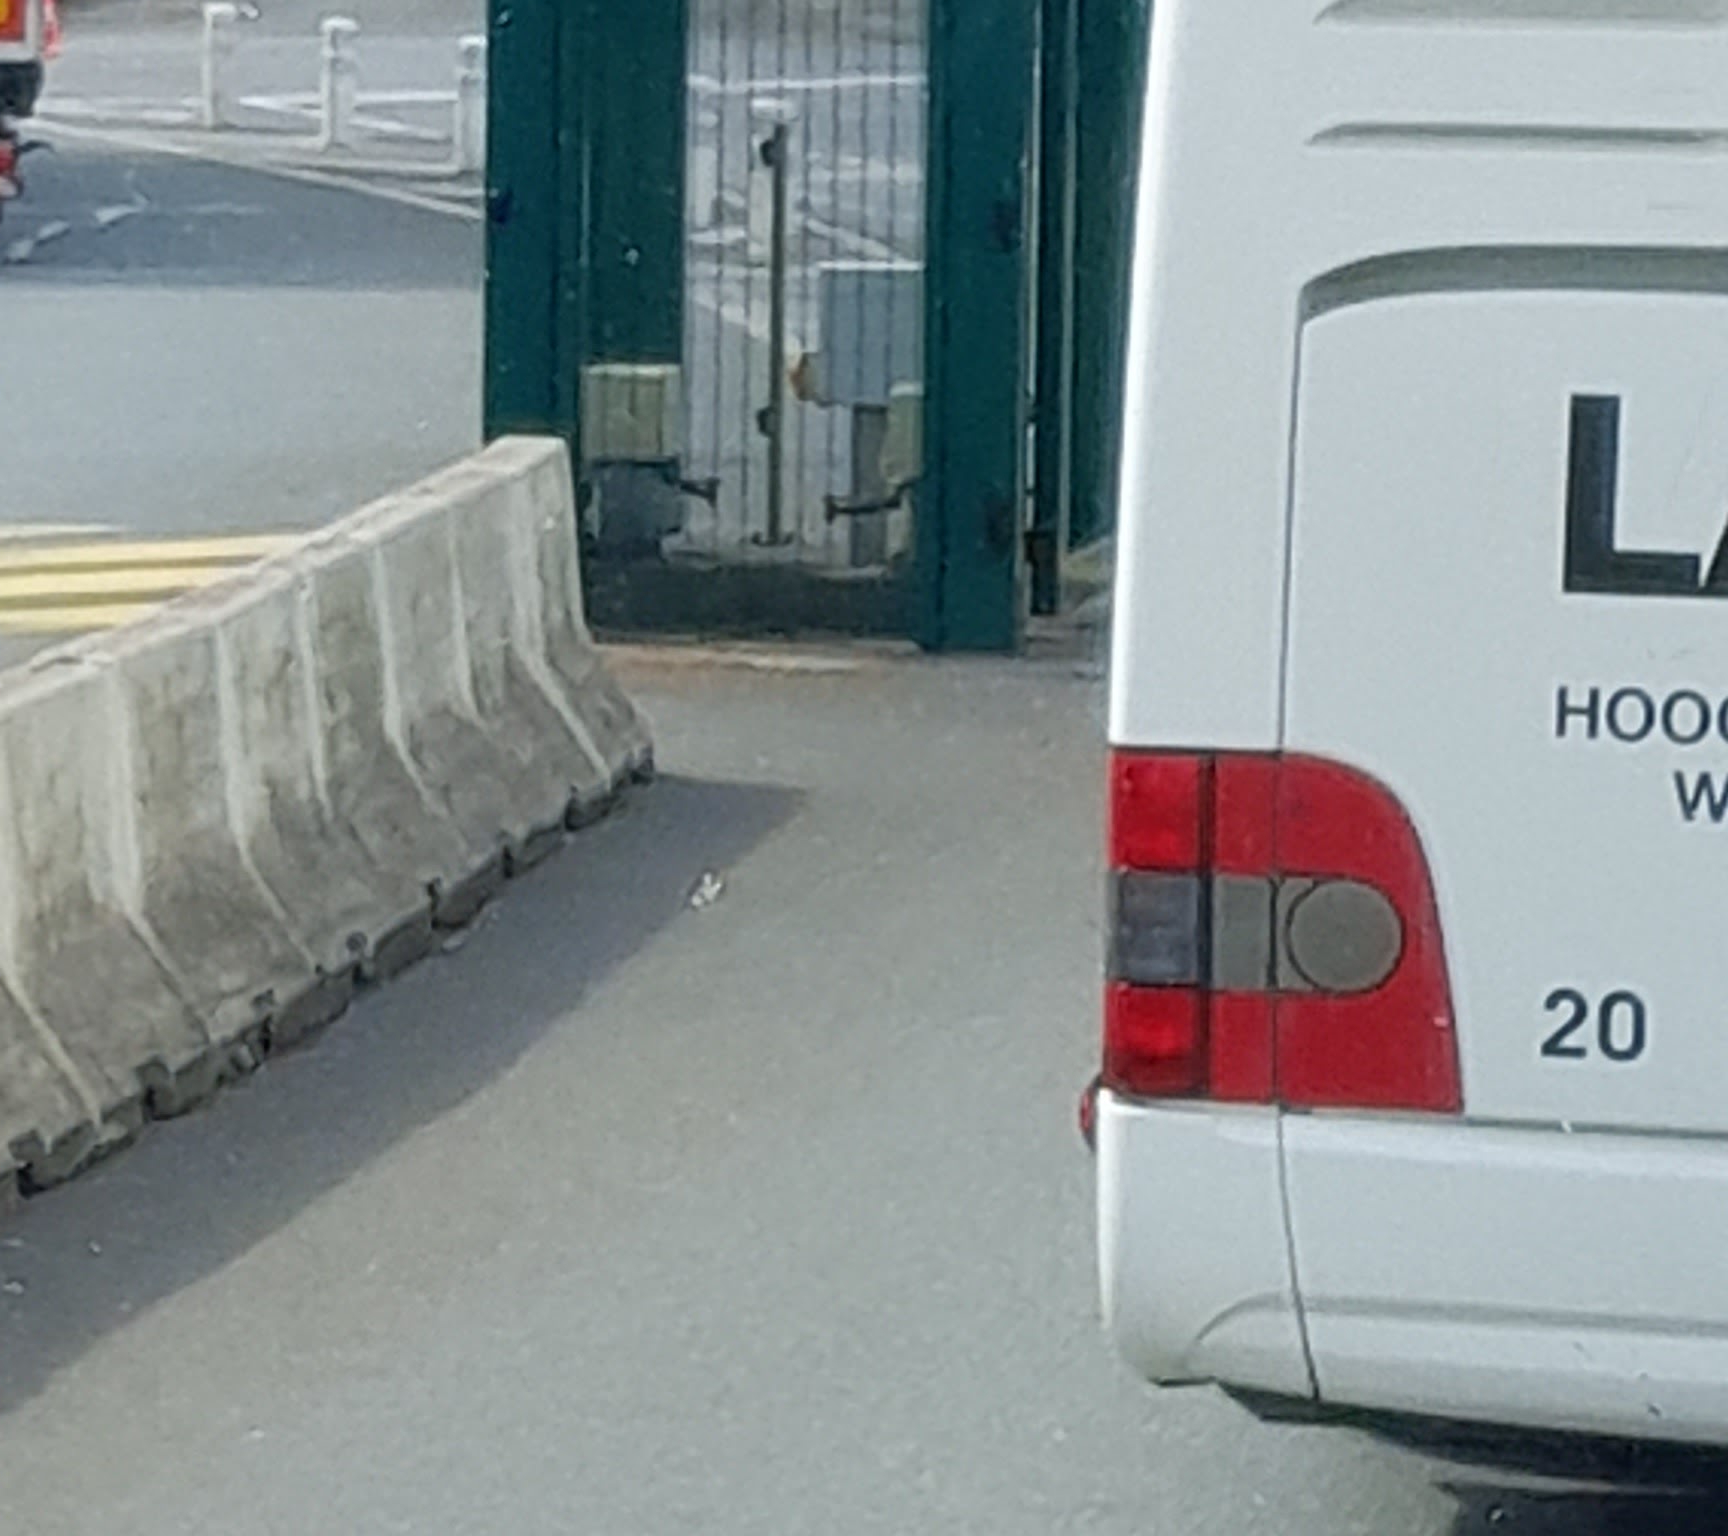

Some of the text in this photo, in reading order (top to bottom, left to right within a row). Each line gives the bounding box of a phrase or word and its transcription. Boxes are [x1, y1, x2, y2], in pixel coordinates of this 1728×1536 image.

[1562, 392, 1728, 598] L
[1555, 685, 1728, 745] HOO
[1539, 987, 1646, 1062] 20
